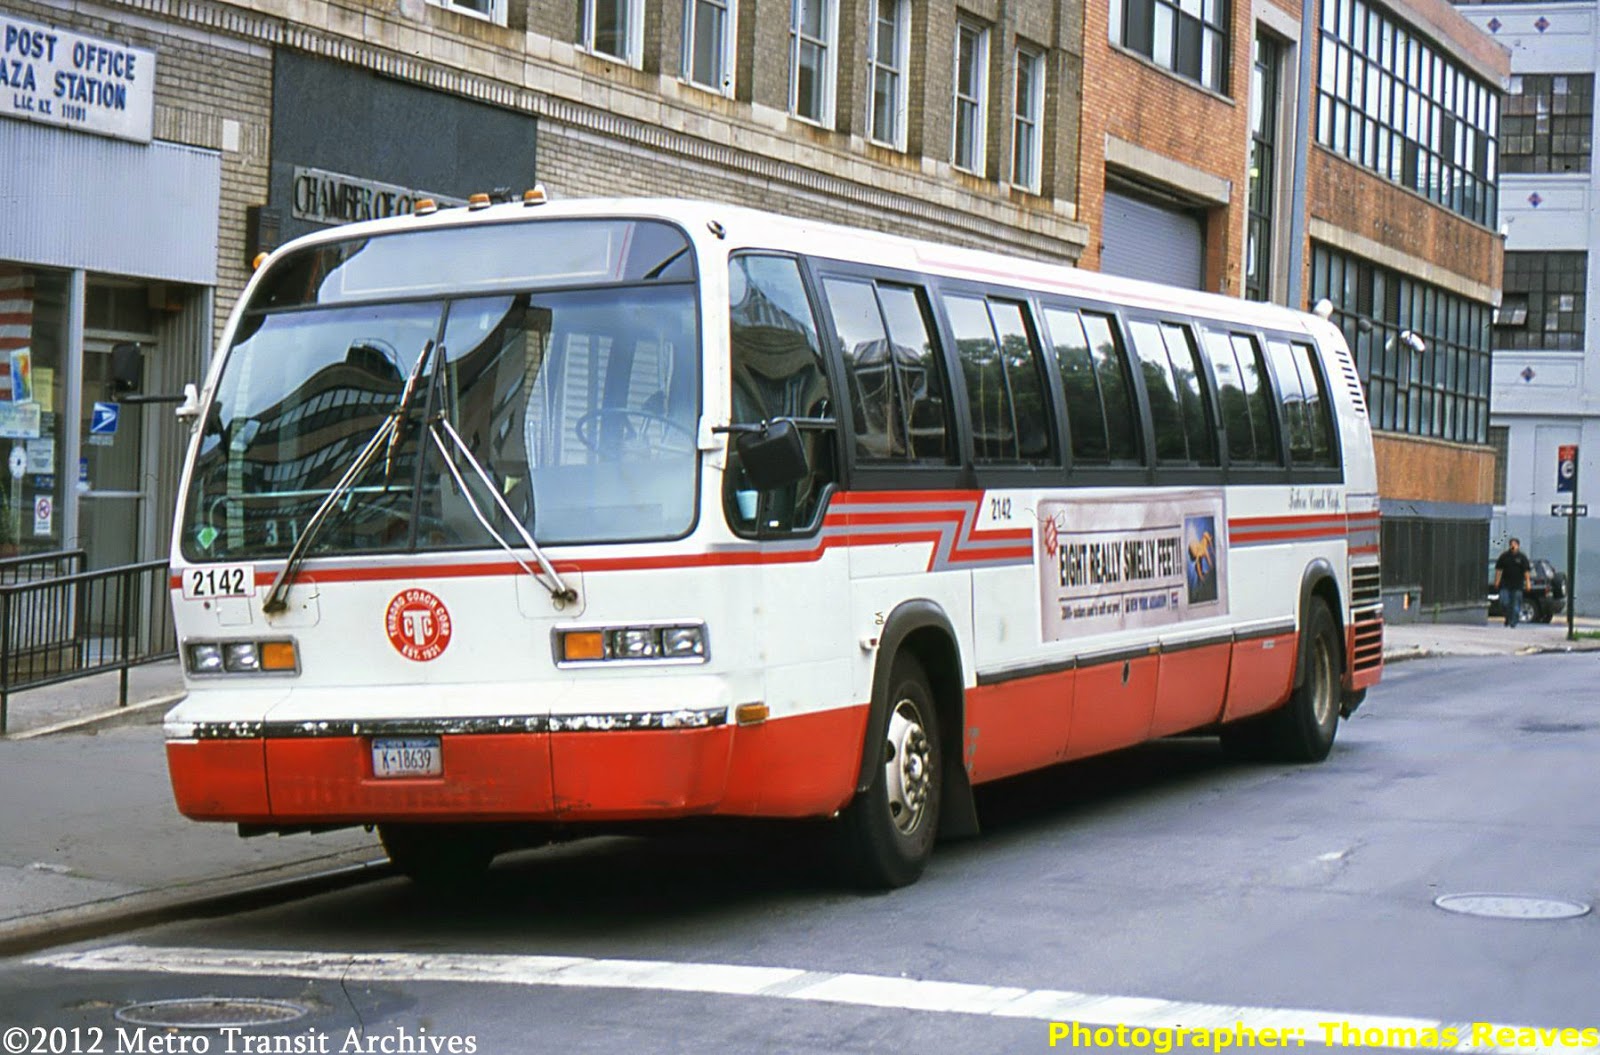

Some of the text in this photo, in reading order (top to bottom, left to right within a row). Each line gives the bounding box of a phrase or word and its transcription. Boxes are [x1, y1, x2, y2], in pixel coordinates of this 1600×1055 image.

[5, 25, 136, 81] POST OFFICE
[54, 70, 127, 111] STATION
[294, 175, 372, 221] CHAMBER
[991, 498, 1012, 521] 2142
[192, 568, 245, 596] 2142
[1059, 543, 1087, 587] EIGHT
[1089, 541, 1121, 584] REALLY
[1123, 538, 1156, 581] SMELLY
[406, 590, 438, 608] COACH
